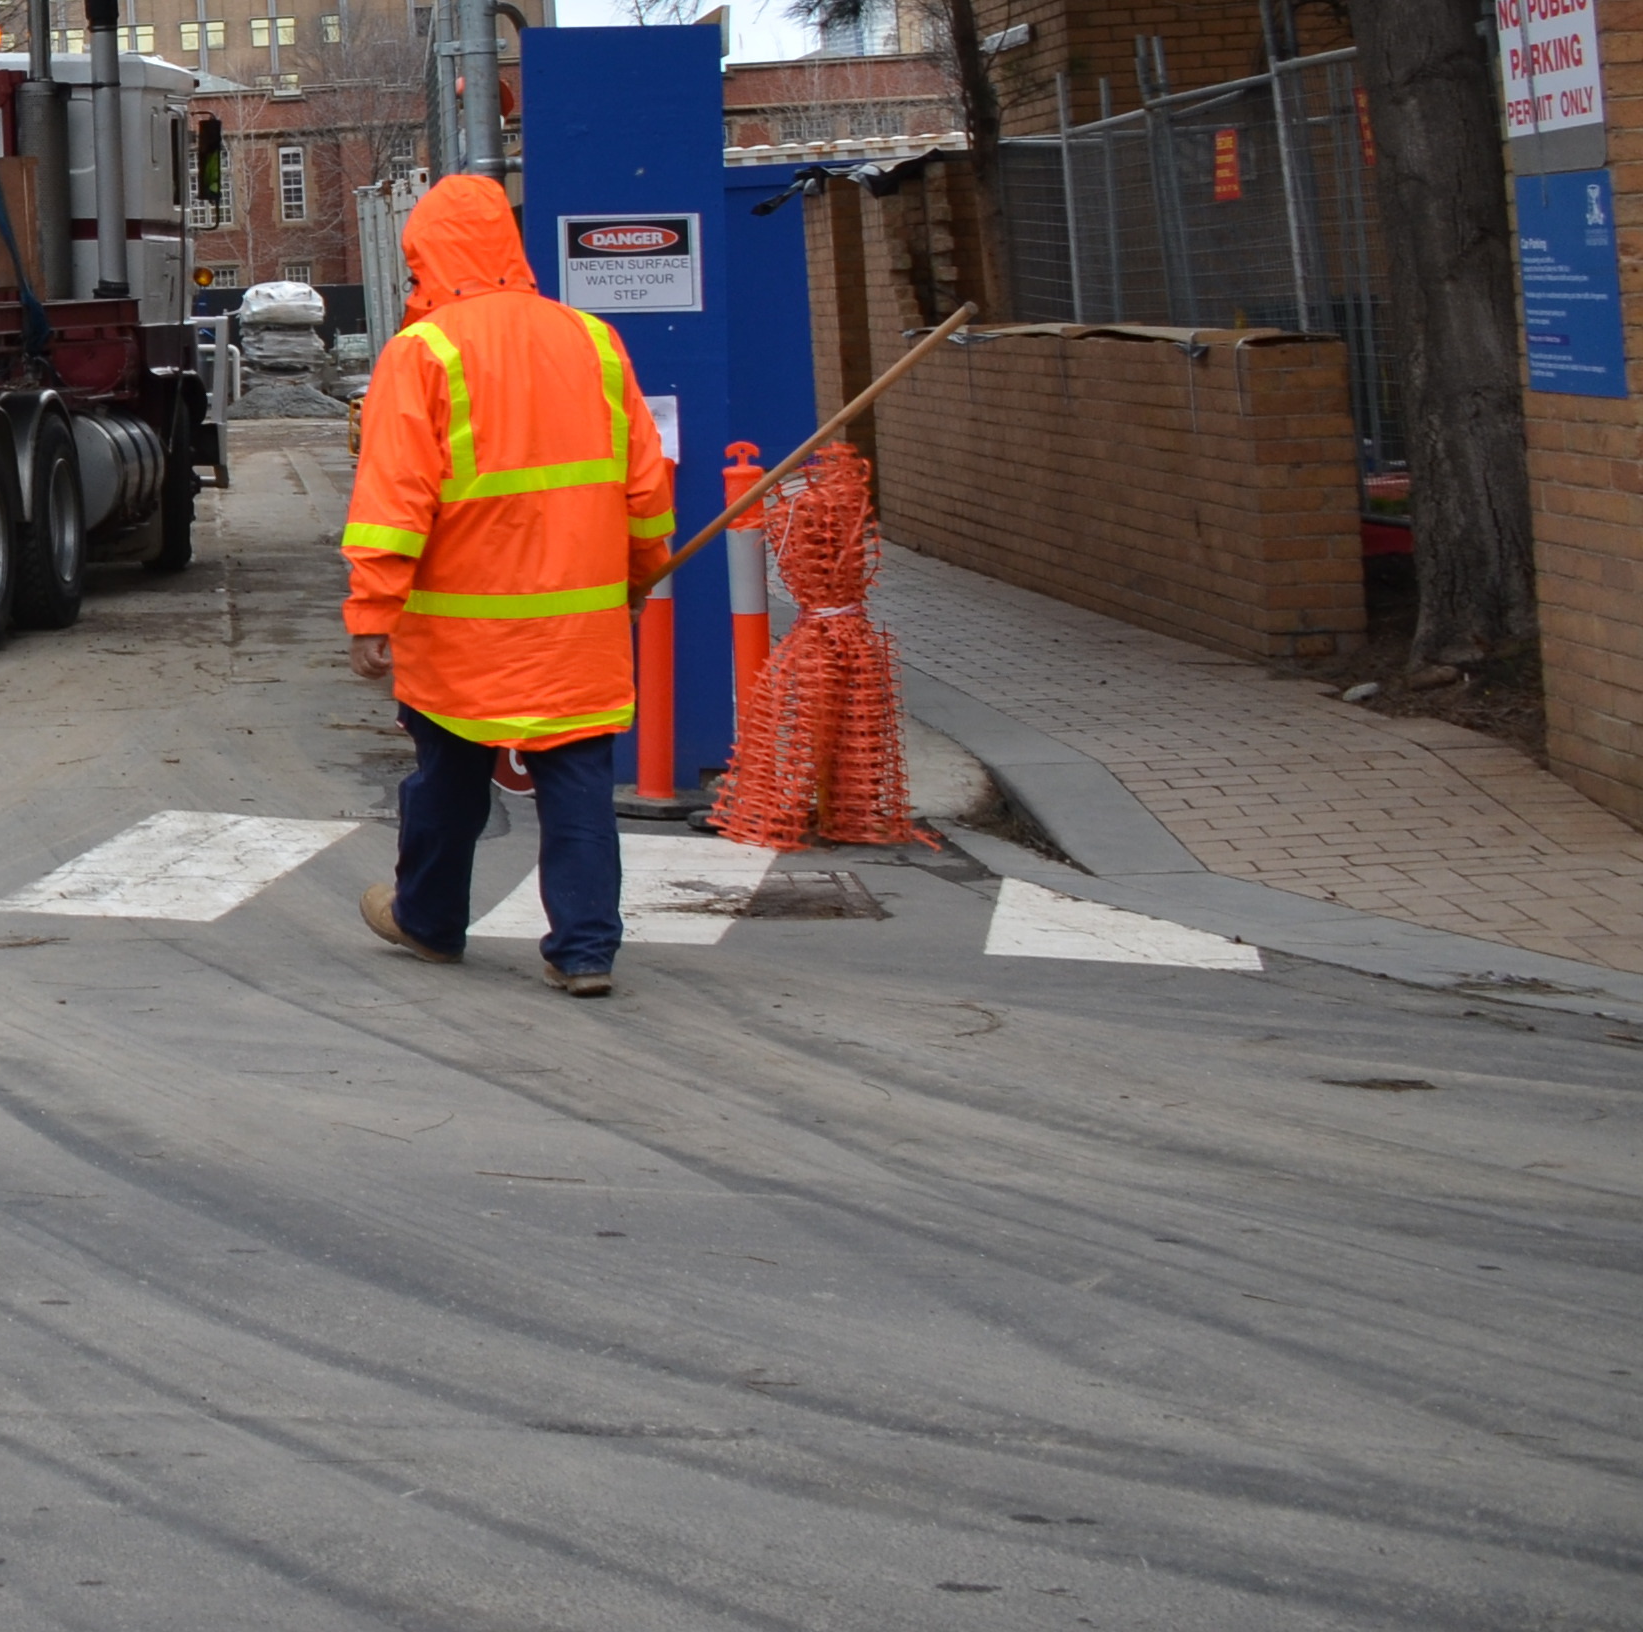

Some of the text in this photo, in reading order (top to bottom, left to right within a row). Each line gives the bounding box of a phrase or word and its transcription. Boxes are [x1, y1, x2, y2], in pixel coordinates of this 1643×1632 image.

[1509, 33, 1583, 80] PARKING
[1507, 86, 1593, 127] PERMIT ONLY
[592, 231, 664, 246] DANGER
[570, 257, 689, 271] UNEVEN SURFACE
[585, 273, 674, 286] WATCH YOUR
[613, 289, 648, 301] STEP
